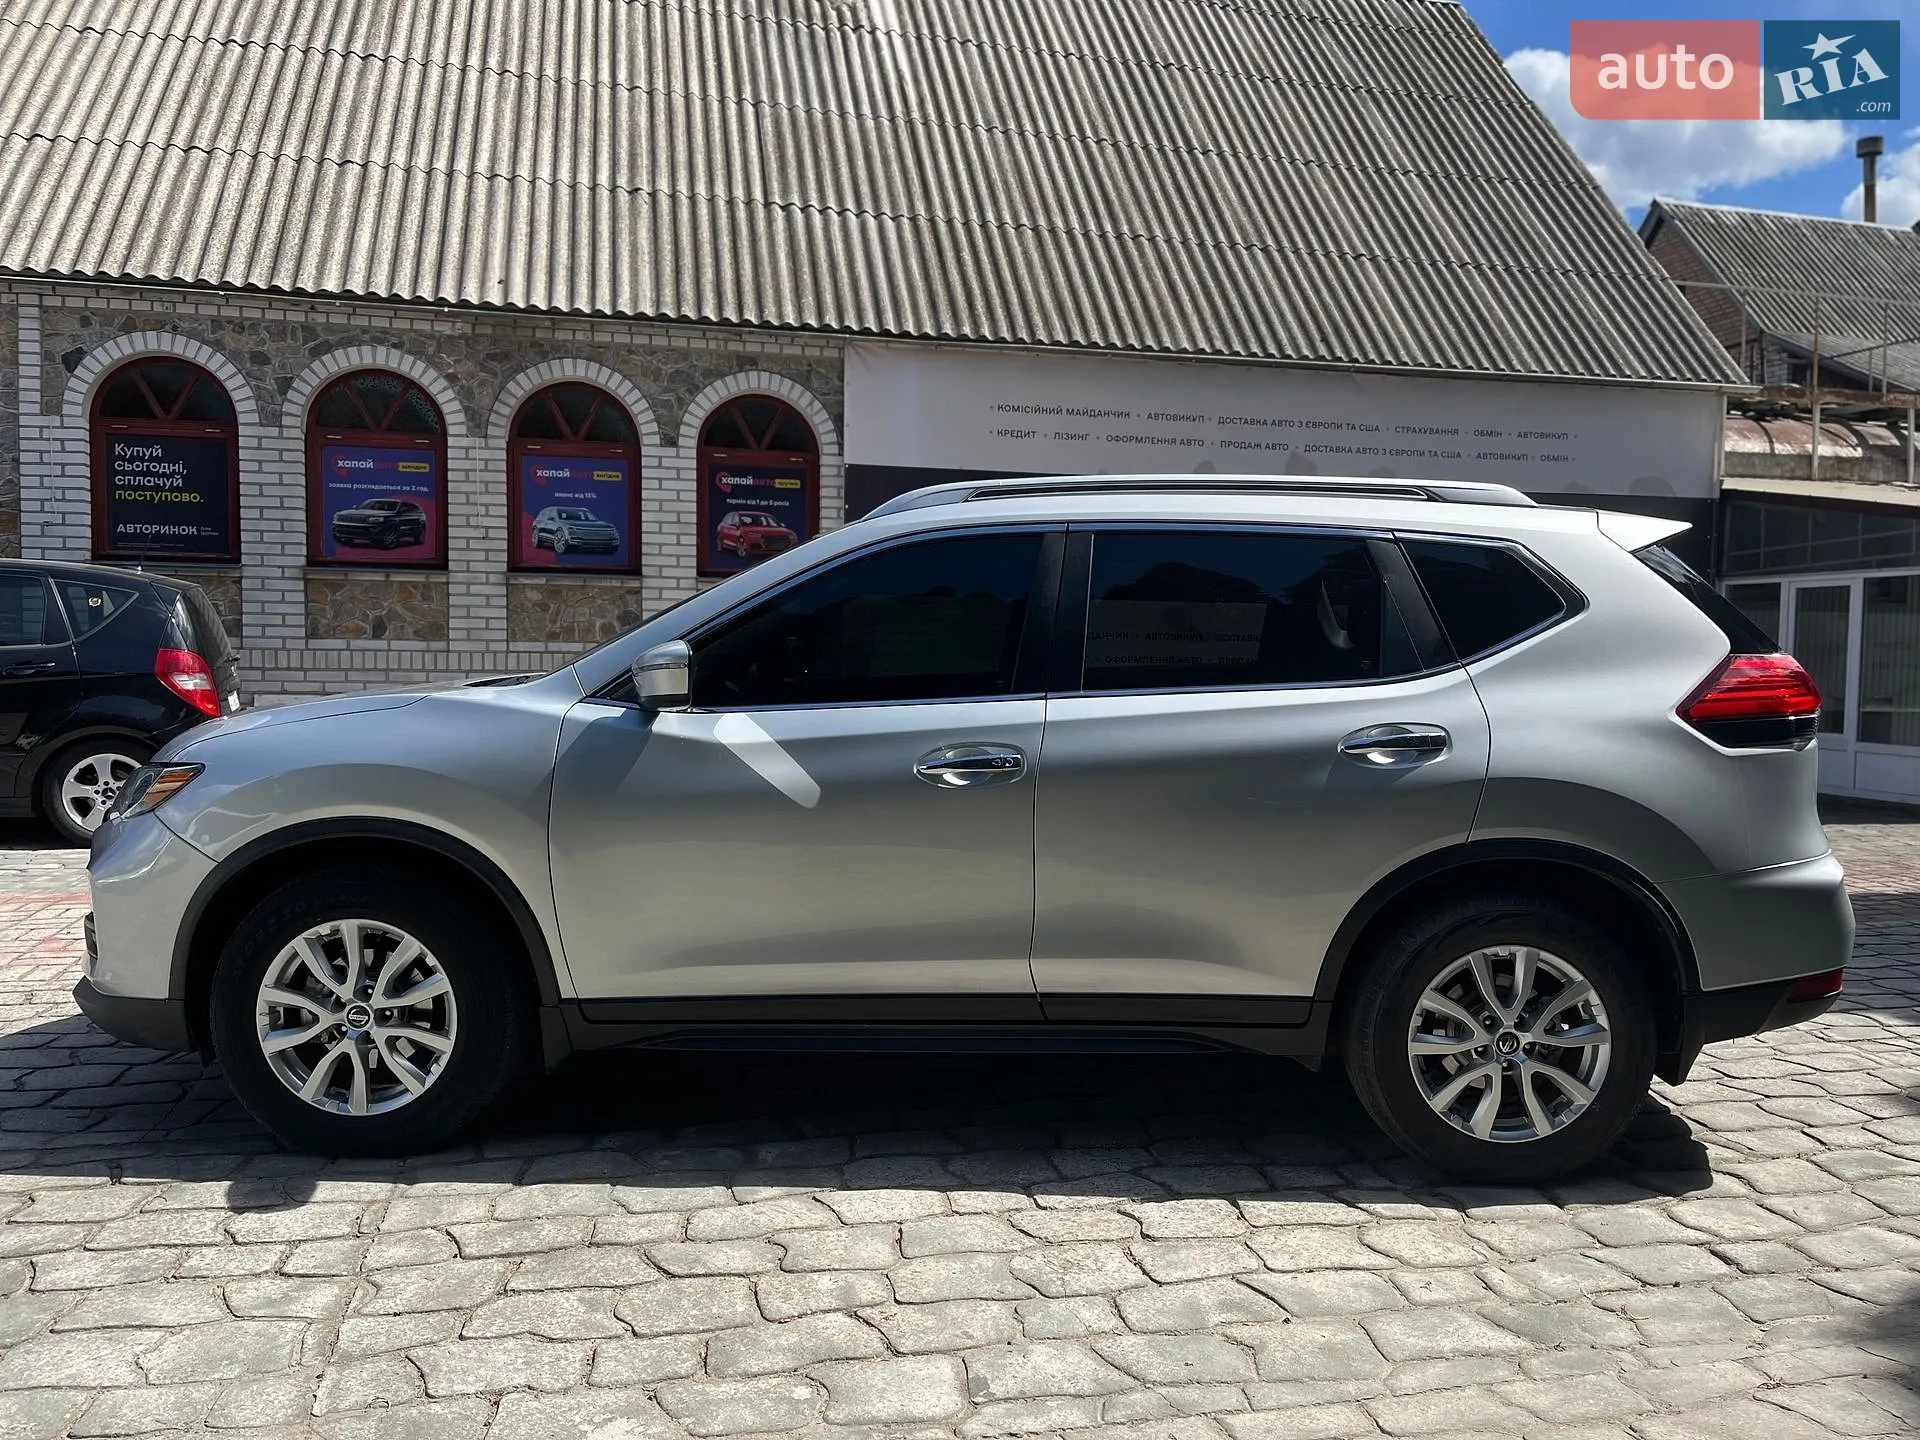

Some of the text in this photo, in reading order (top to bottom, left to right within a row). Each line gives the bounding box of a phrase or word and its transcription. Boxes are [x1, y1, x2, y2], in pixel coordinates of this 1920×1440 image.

[997, 403, 1064, 416] КОМІСІЙНИЙ
[1065, 406, 1131, 420] МАЙДАНЧИК
[1146, 411, 1206, 424] АВТОВИКУП
[1217, 415, 1269, 427] ДОСТАВКА
[1270, 418, 1296, 428] АВТО
[1305, 420, 1343, 431] ЄВРОПИ
[1345, 422, 1357, 431] ТА
[1358, 423, 1381, 433] США
[1394, 425, 1460, 437] СТРАХУВАННЯ
[1473, 429, 1503, 439] ОБМІН
[1516, 431, 1569, 441] АВТОВИКУП
[114, 442, 162, 459] Купуй
[996, 428, 1037, 440] КРЕДИТ
[1053, 431, 1091, 442] ЛІЗИНГ
[1105, 433, 1178, 447] ОФОРМЛЕННЯ
[1179, 438, 1205, 448] АВТО
[1219, 440, 1263, 451] ПРОДАЖ
[1264, 441, 1289, 452] АВТО
[1303, 443, 1353, 455] ДОСТАВКА
[1355, 446, 1380, 457] АВТО
[1388, 448, 1426, 458] ЄВРОПИ
[1427, 449, 1440, 459] ТА
[1440, 450, 1462, 460] США
[1476, 452, 1529, 463] АВТОВИКУП
[1540, 454, 1569, 464] ОБМІН
[114, 460, 188, 475] сьогодні,
[114, 474, 183, 489] сплачуй
[115, 490, 204, 504] поступово.
[116, 523, 198, 536] АВТОРИНОК
